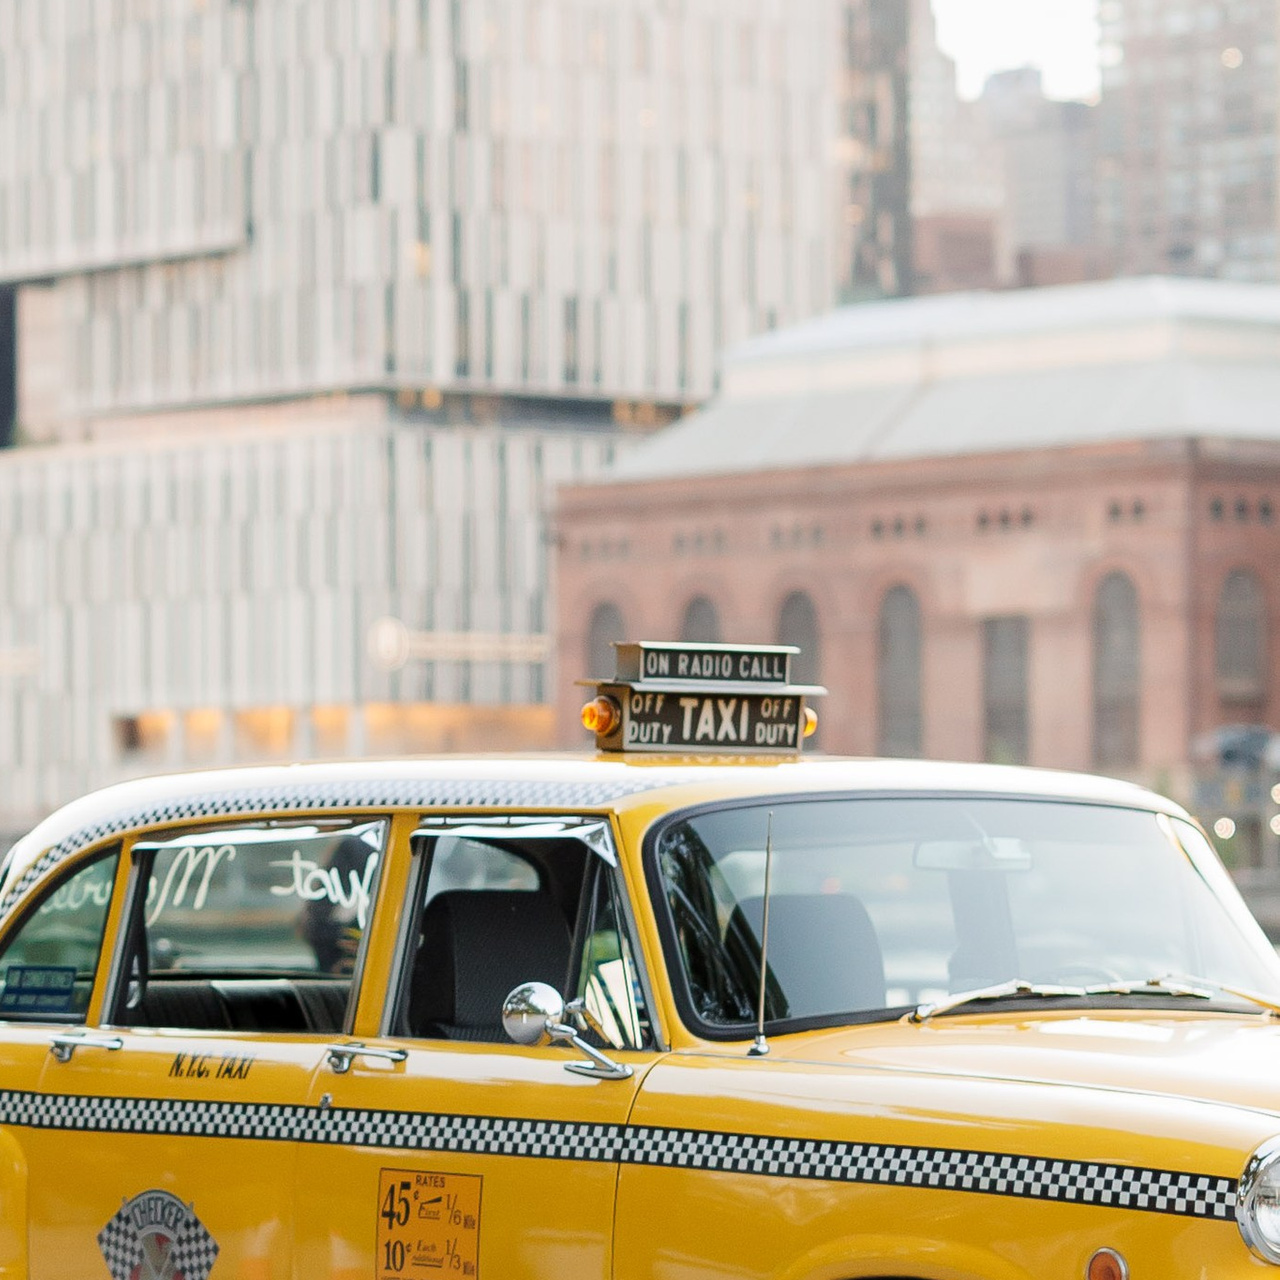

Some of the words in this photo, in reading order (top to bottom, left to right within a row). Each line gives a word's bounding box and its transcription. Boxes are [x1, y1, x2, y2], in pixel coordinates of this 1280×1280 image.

[647, 654, 669, 676] ON
[677, 654, 732, 677] RADIO
[739, 655, 783, 679] CALL
[631, 694, 665, 714] OFF
[761, 698, 792, 718] OFF
[679, 697, 749, 741] TAXI
[629, 721, 672, 744] DUTY
[755, 722, 795, 745] DUTY
[215, 1053, 255, 1079] TAXI
[416, 1175, 445, 1188] RATES
